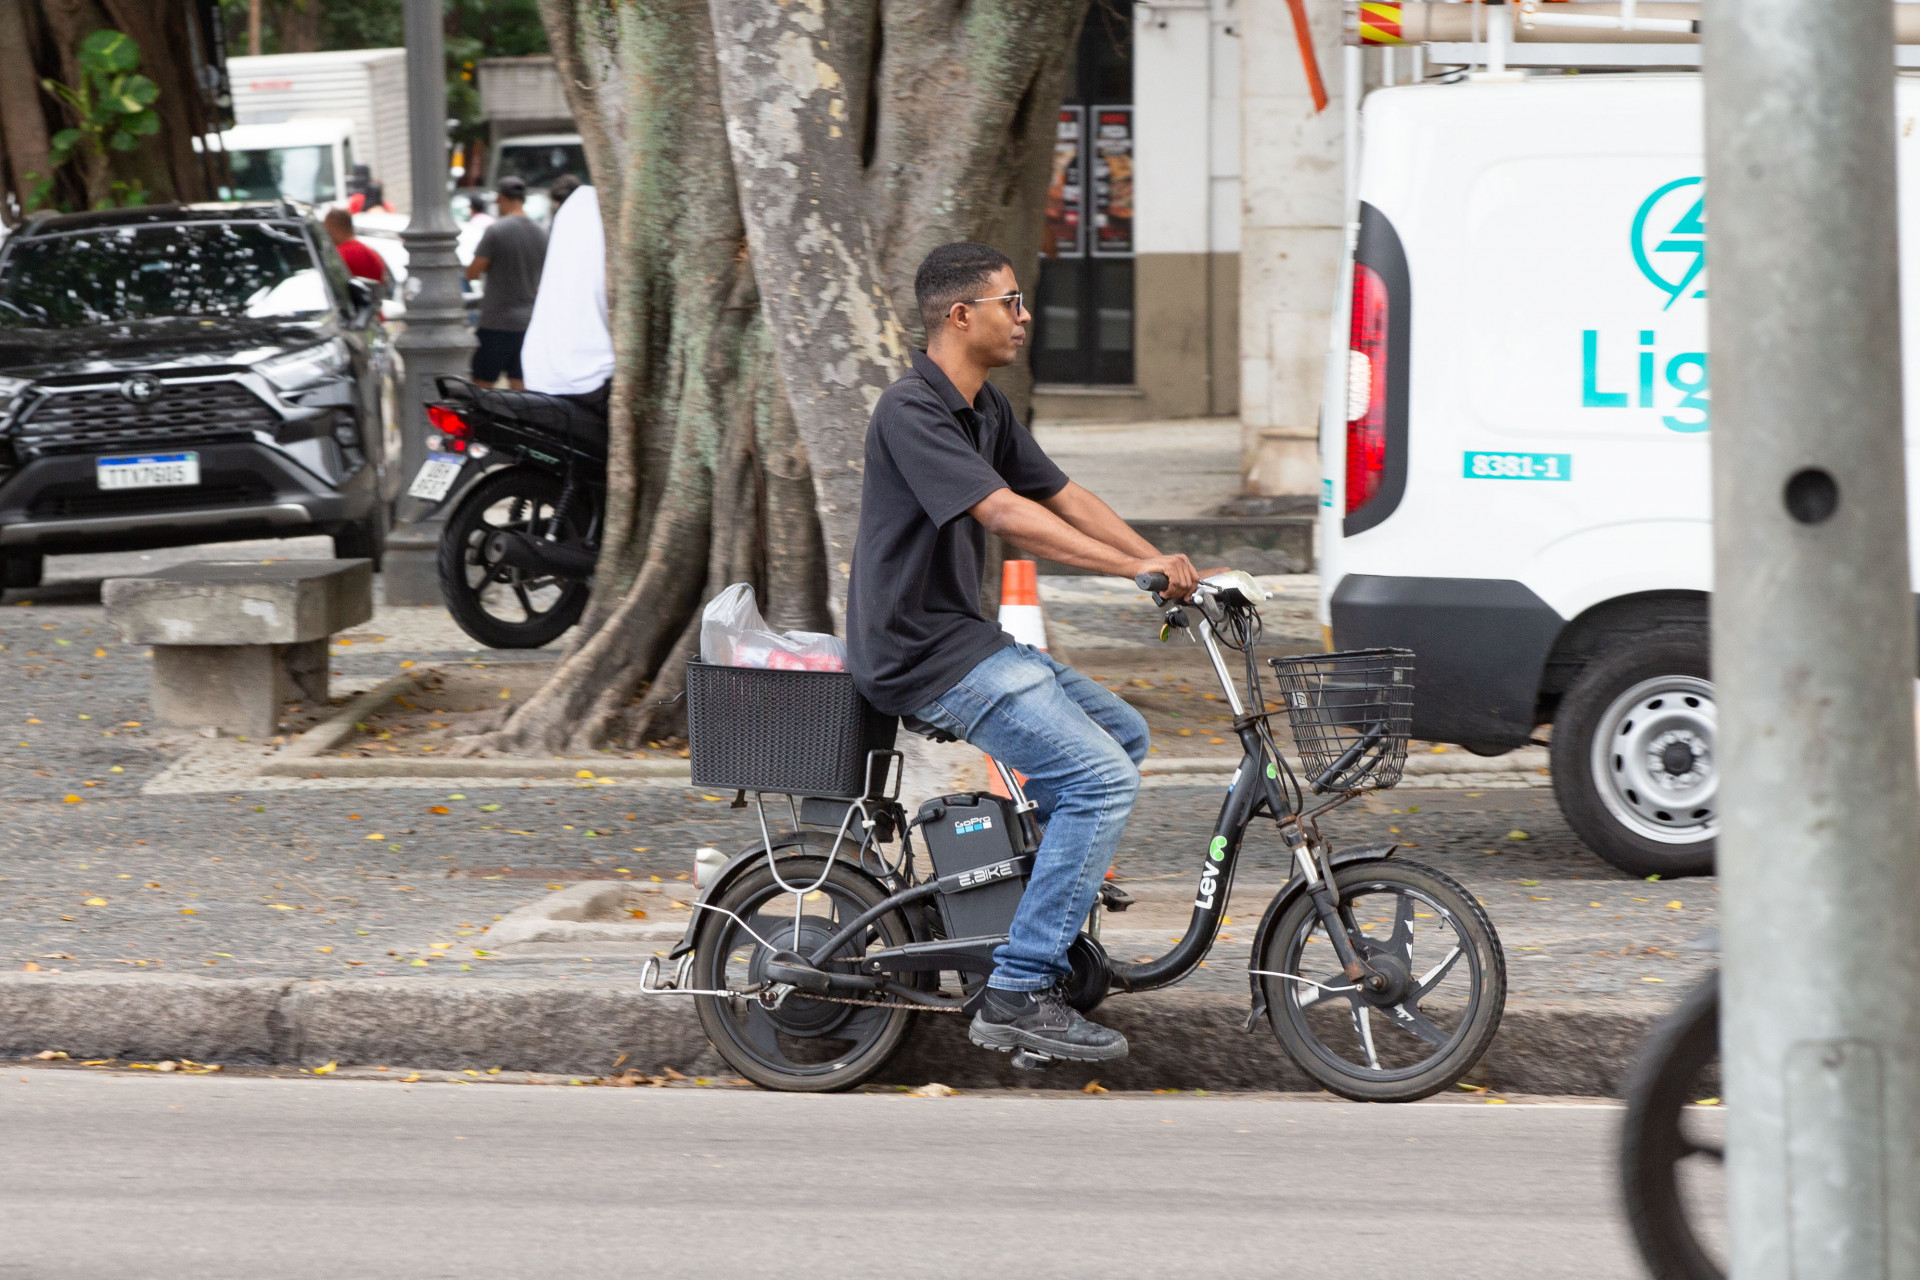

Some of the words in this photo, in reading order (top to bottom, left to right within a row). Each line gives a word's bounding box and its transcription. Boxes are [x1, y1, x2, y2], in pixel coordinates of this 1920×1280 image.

[1471, 454, 1562, 478] 8381-1
[954, 816, 991, 828] GoPro
[959, 863, 1013, 887] E.BIKE
[1195, 861, 1220, 910] Lev
